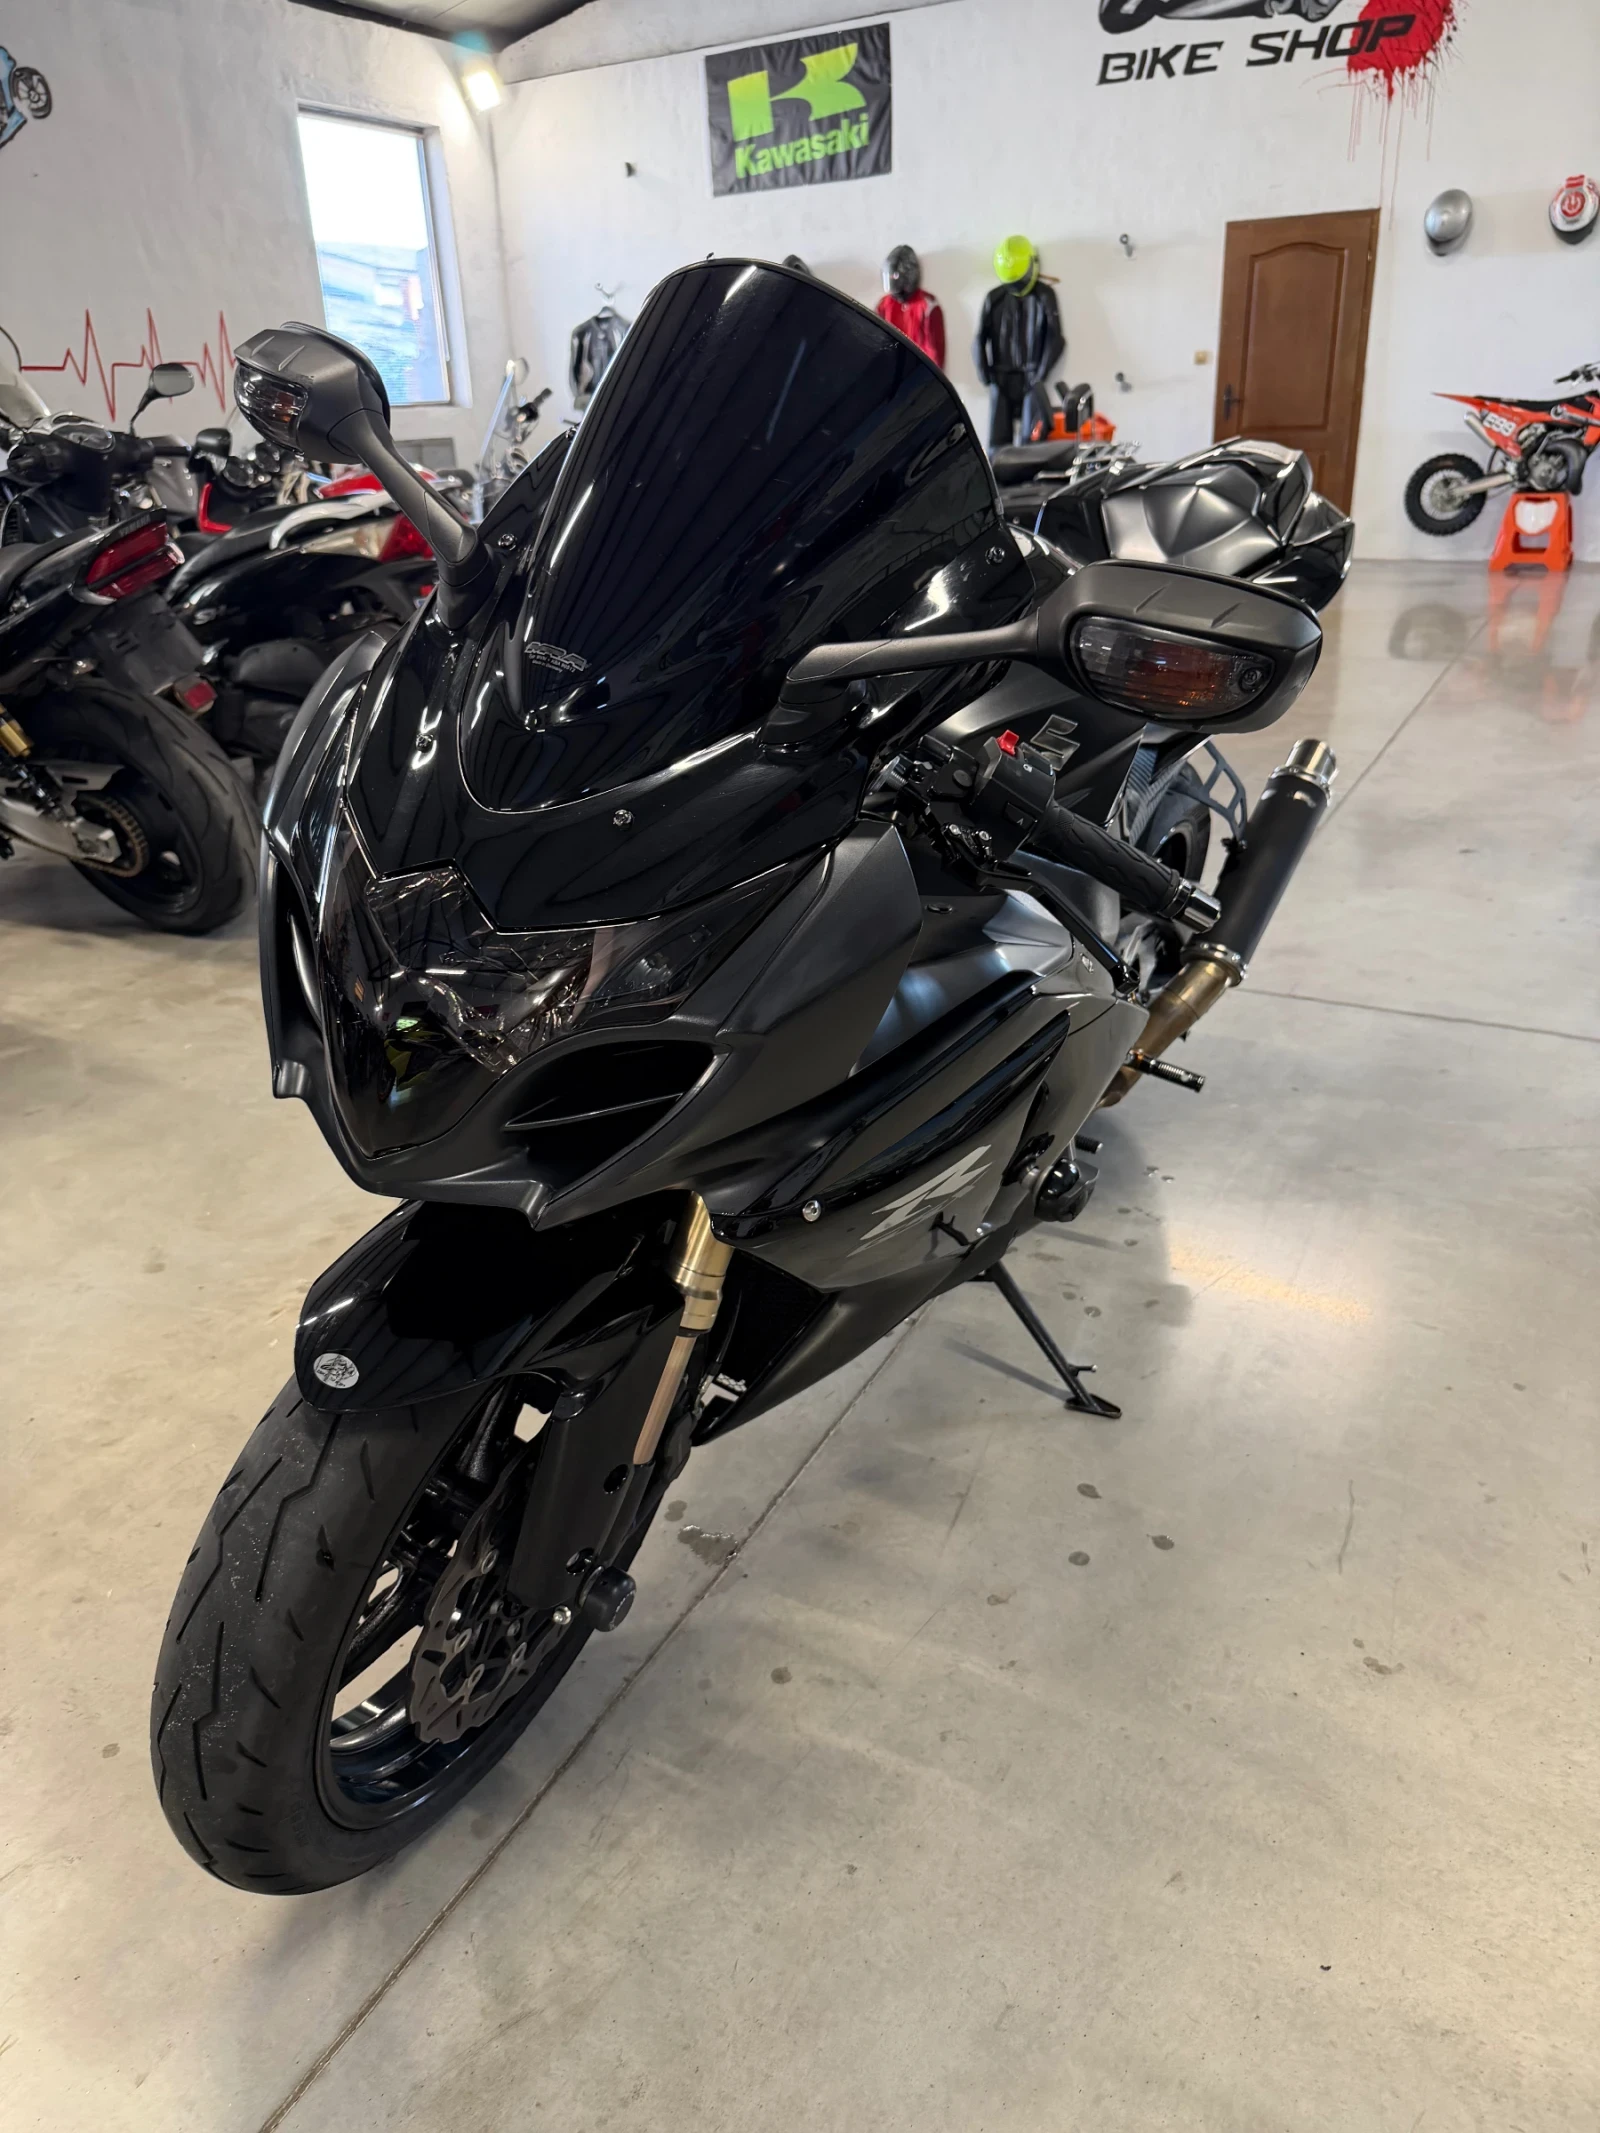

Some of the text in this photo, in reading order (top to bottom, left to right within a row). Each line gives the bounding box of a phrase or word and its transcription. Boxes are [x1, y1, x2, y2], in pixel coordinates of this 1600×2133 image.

[1096, 14, 1416, 85] BIKE SHOP
[735, 113, 869, 179] Kawasaki
